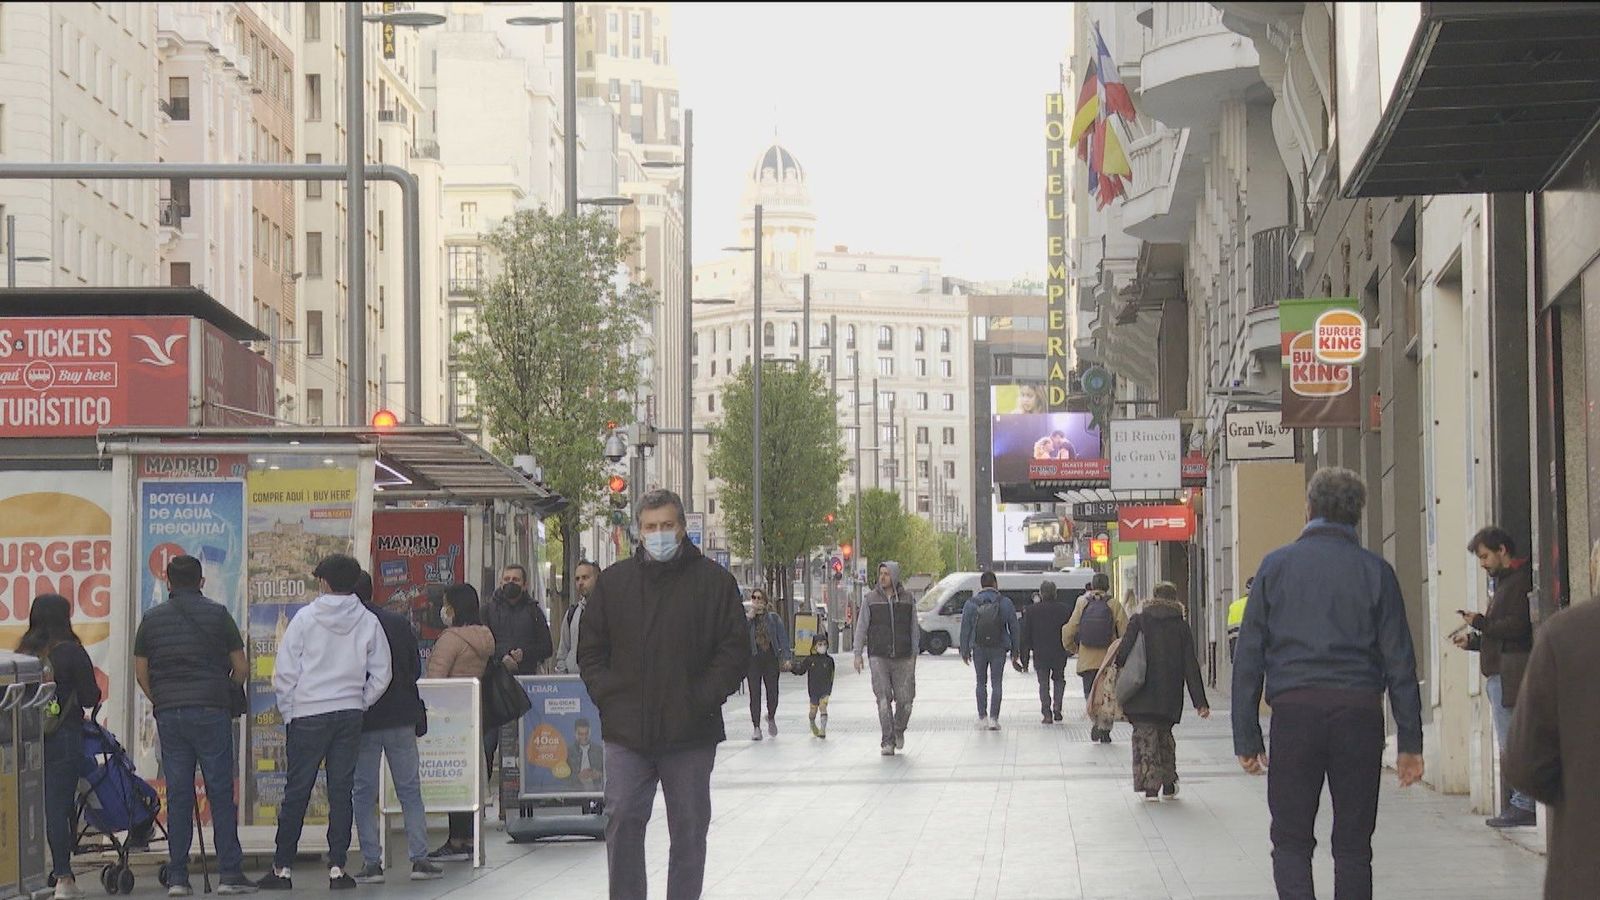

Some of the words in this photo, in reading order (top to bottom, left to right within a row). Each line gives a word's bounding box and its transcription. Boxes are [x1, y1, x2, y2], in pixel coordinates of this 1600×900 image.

[1046, 94, 1064, 220] HOTEL
[1046, 236, 1065, 405] EMPERAD
[1319, 326, 1362, 336] BURGER
[24, 328, 112, 357] TICKETS
[1318, 336, 1362, 350] KING
[58, 369, 83, 384] Buy
[85, 368, 112, 381] here
[1293, 364, 1350, 382] KING
[0, 391, 111, 425] TURÍSTICO
[1115, 431, 1128, 442] El
[1132, 430, 1176, 441] Rincón
[1229, 421, 1255, 437] Gran
[1114, 451, 1127, 462] de
[1129, 450, 1156, 462] Gran
[144, 456, 220, 475] MADRID
[252, 491, 284, 503] COMPRE
[313, 490, 329, 501] BUY
[330, 489, 351, 501] HERE
[173, 508, 212, 519] AGUA
[1121, 518, 1187, 529] VIPS
[378, 535, 440, 550] MADRID
[255, 579, 306, 597] TOLEDO
[527, 684, 559, 693] LEBARA
